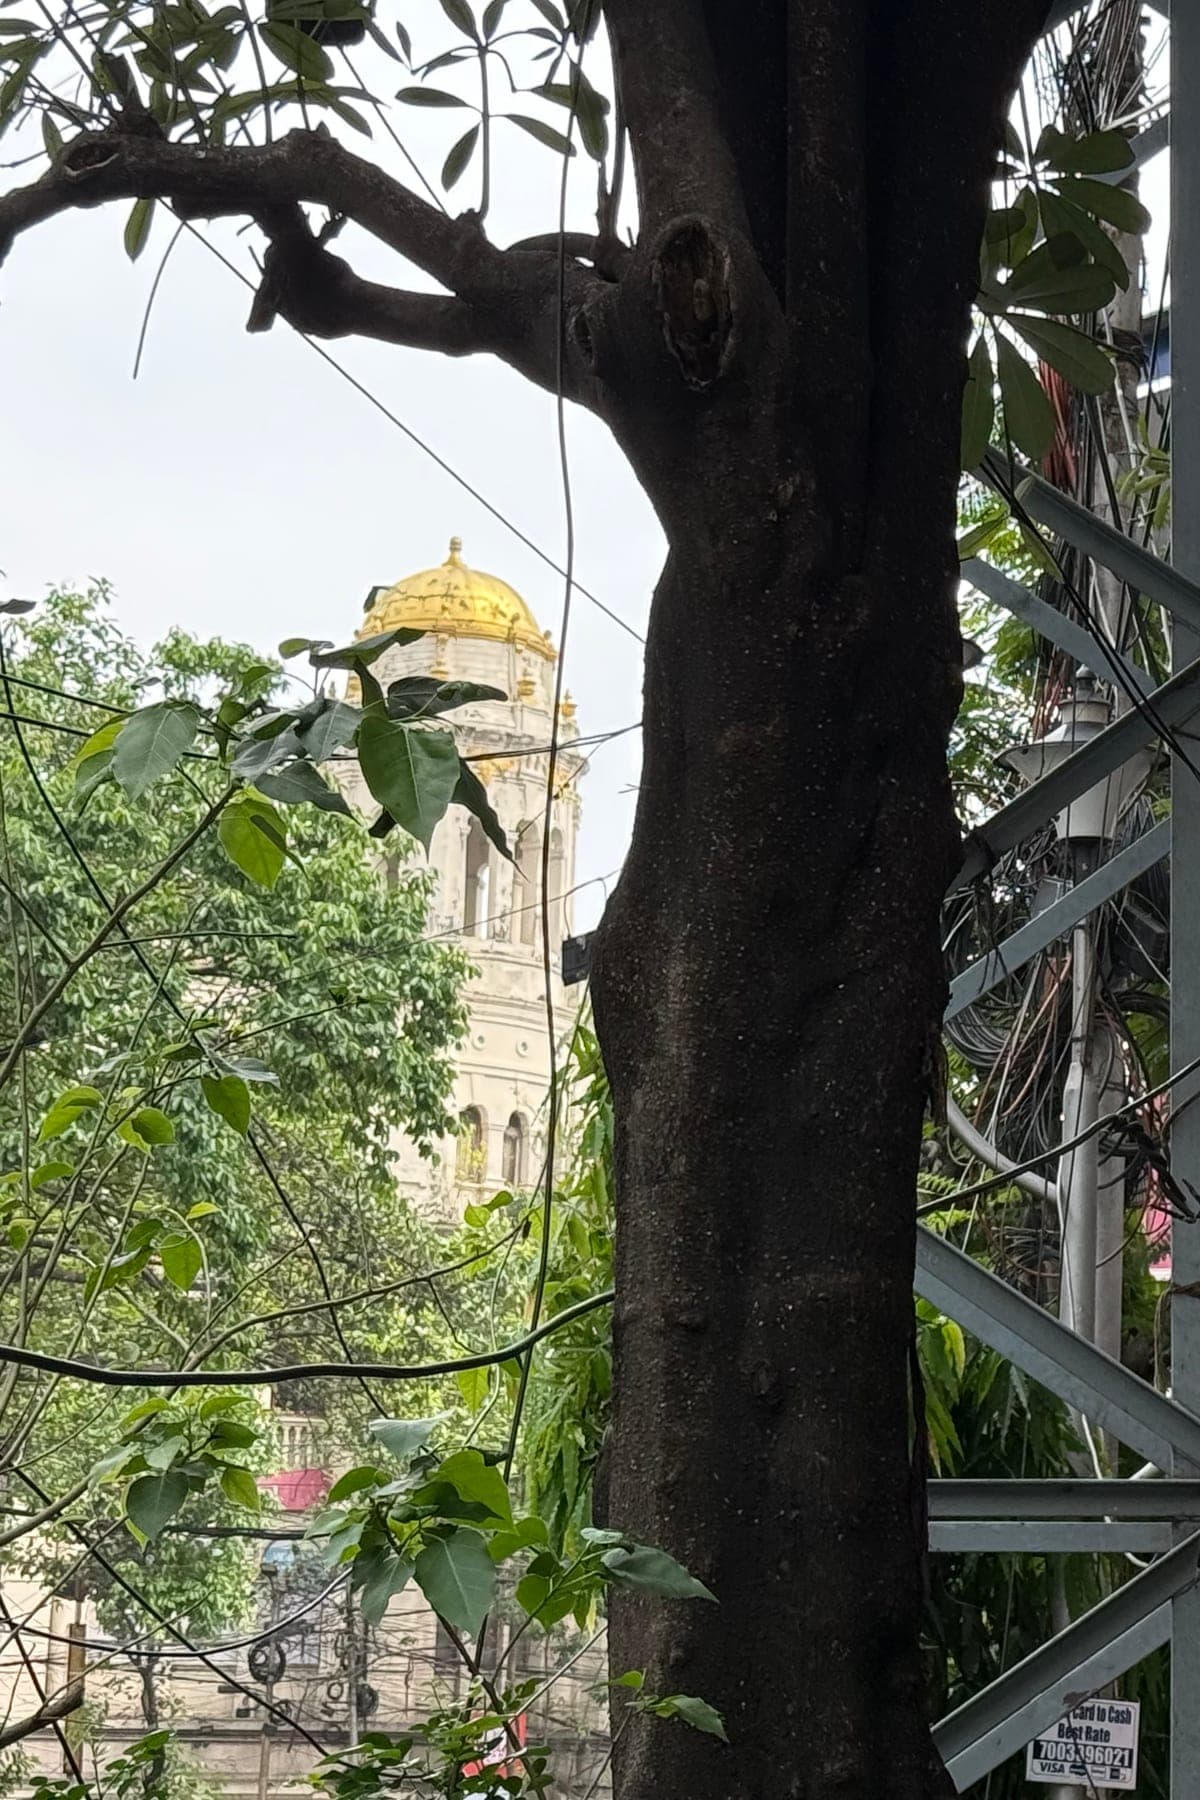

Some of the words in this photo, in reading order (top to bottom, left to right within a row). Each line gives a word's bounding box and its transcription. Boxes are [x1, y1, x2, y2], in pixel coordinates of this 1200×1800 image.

[1108, 1705, 1131, 1726] Cash
[1057, 1722, 1083, 1741] Best
[1085, 1725, 1111, 1743] Rate
[1040, 1761, 1065, 1774] VISA
